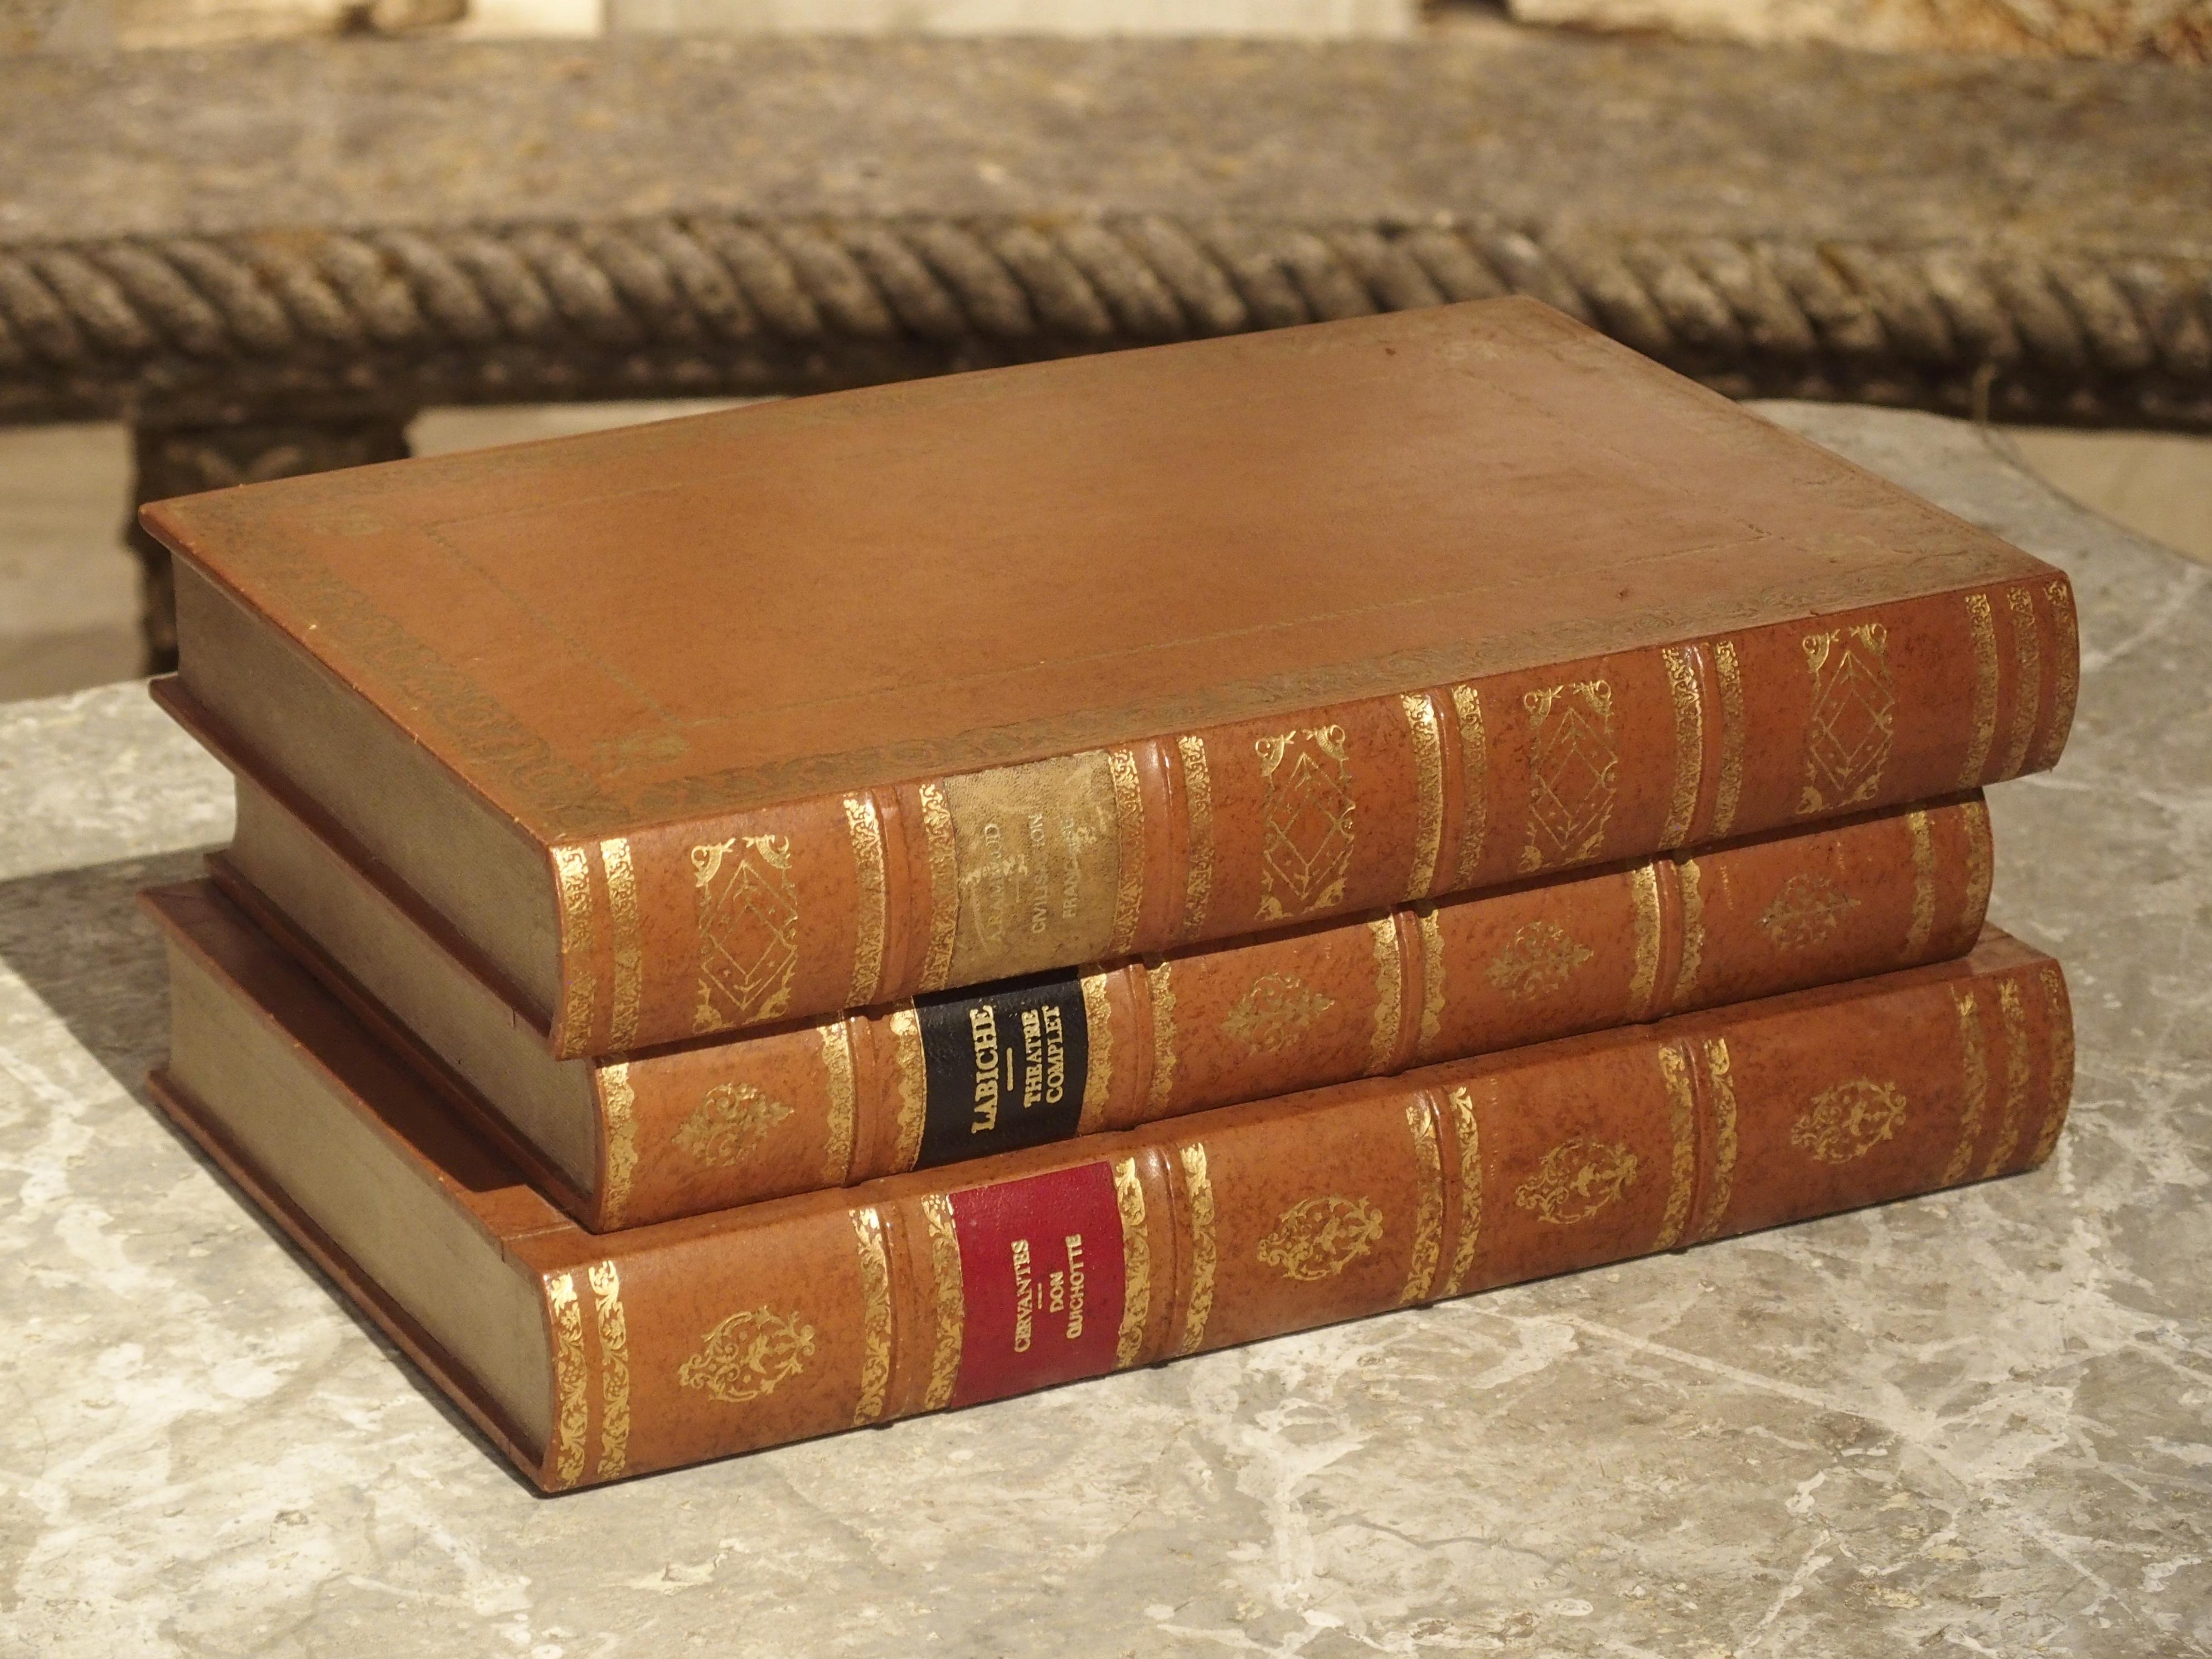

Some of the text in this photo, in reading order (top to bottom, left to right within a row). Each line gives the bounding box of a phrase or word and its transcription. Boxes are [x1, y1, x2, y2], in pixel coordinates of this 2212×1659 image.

[969, 1005, 999, 1134] LABICHE
[1021, 1008, 1042, 1108] THEATRE
[1041, 1005, 1064, 1104] COMPLET
[1011, 1238, 1033, 1353] CERVANTES
[1049, 1270, 1064, 1313] DON
[1065, 1233, 1085, 1339] QUICHOTTE
